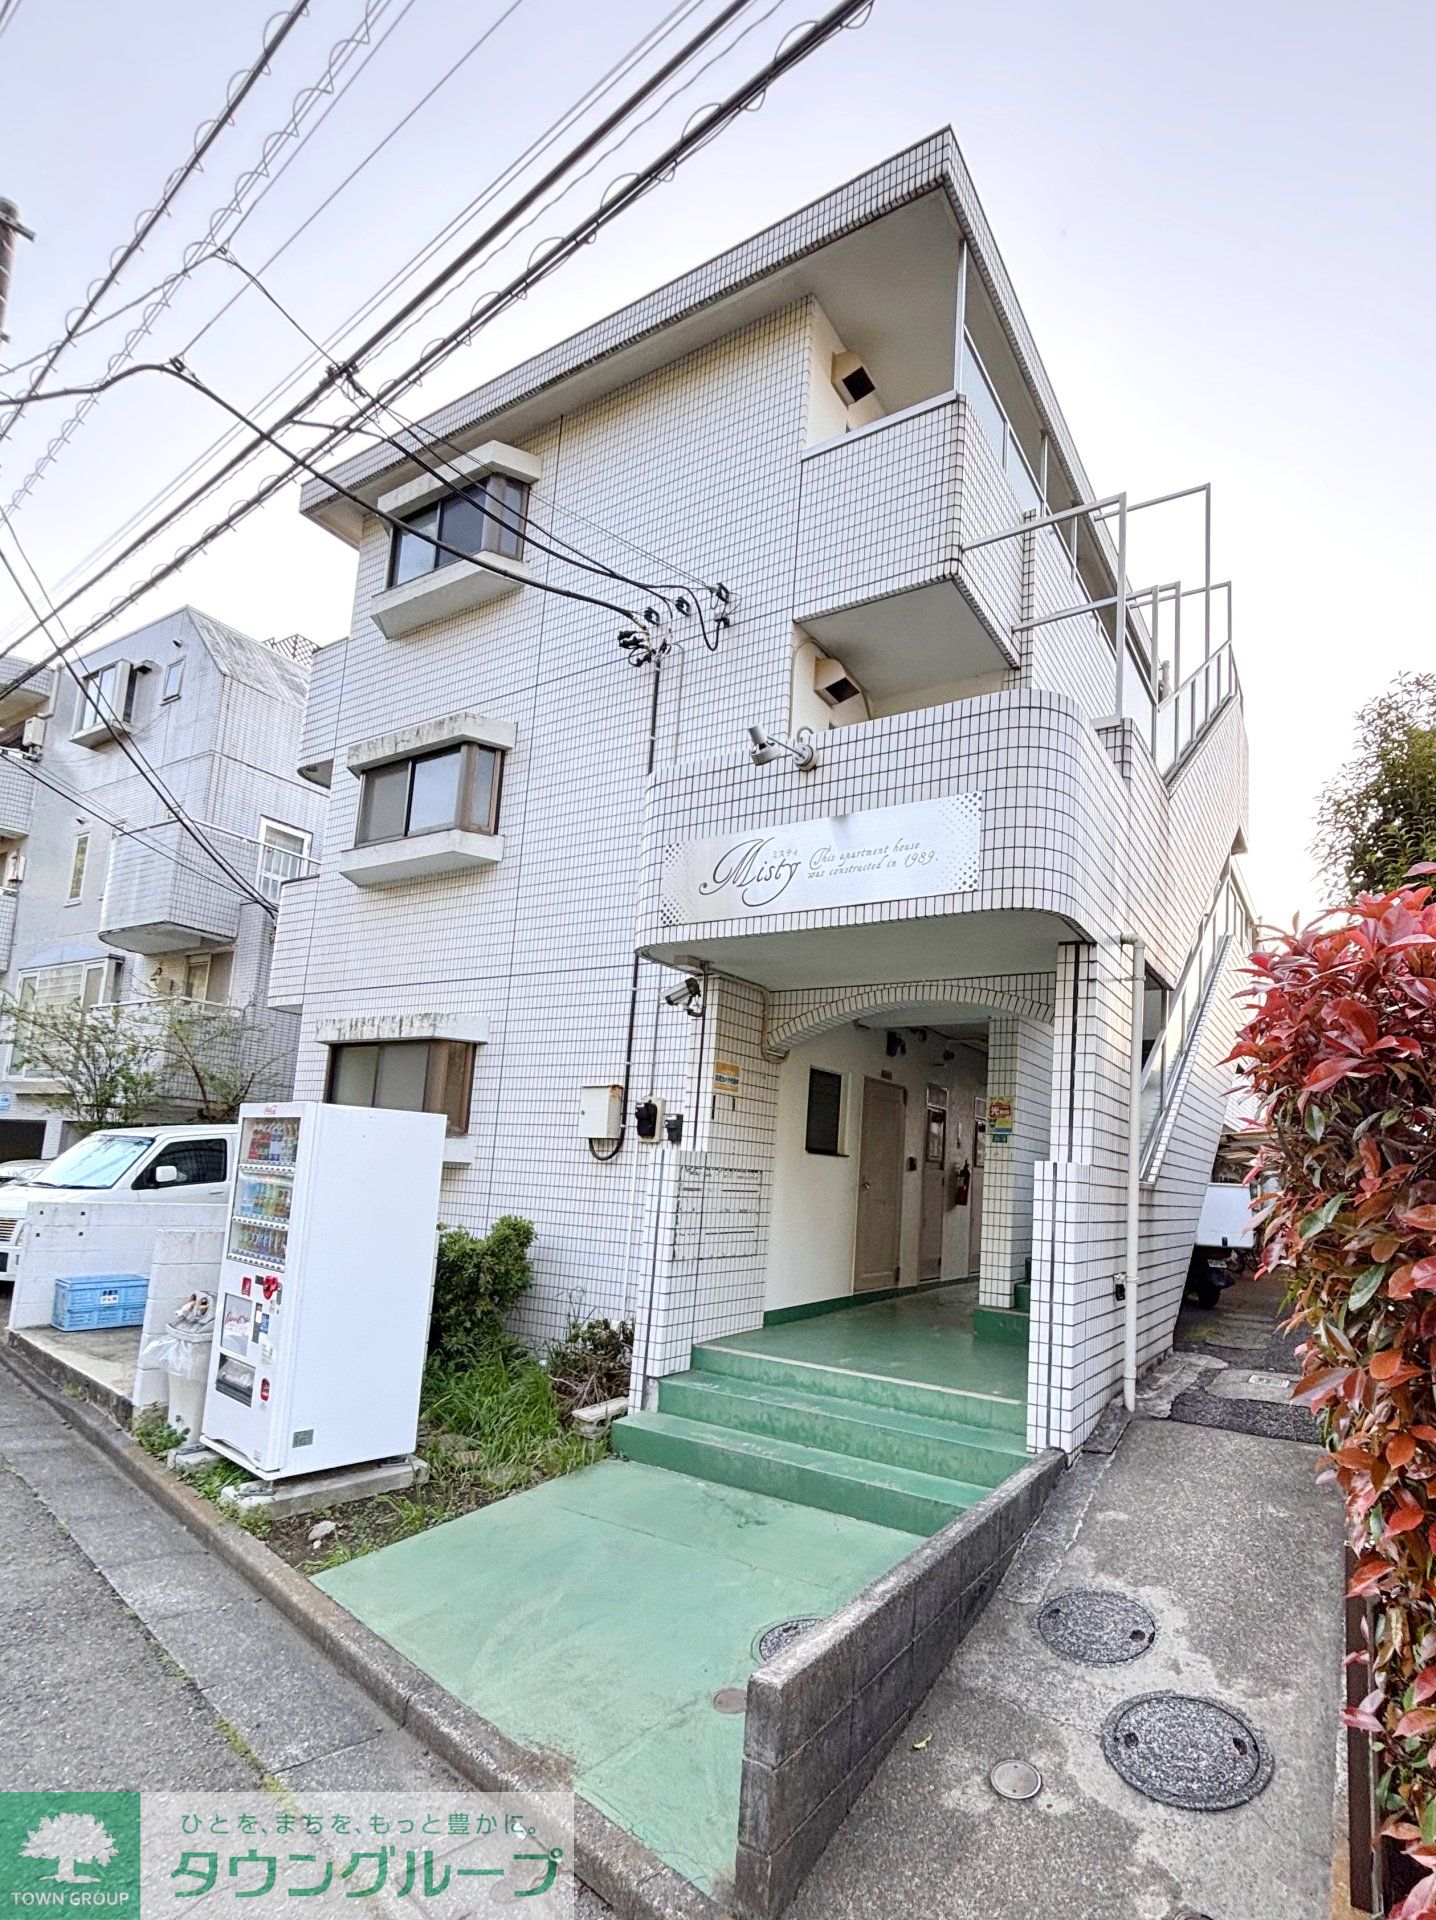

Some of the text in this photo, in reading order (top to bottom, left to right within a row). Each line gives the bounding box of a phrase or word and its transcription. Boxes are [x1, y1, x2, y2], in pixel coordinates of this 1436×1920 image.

[772, 848, 799, 859] ミスティ
[807, 870, 826, 879] was
[829, 854, 890, 876] constructed
[886, 859, 898, 868] in
[809, 837, 921, 871] This apartment house
[698, 836, 802, 907] Misty
